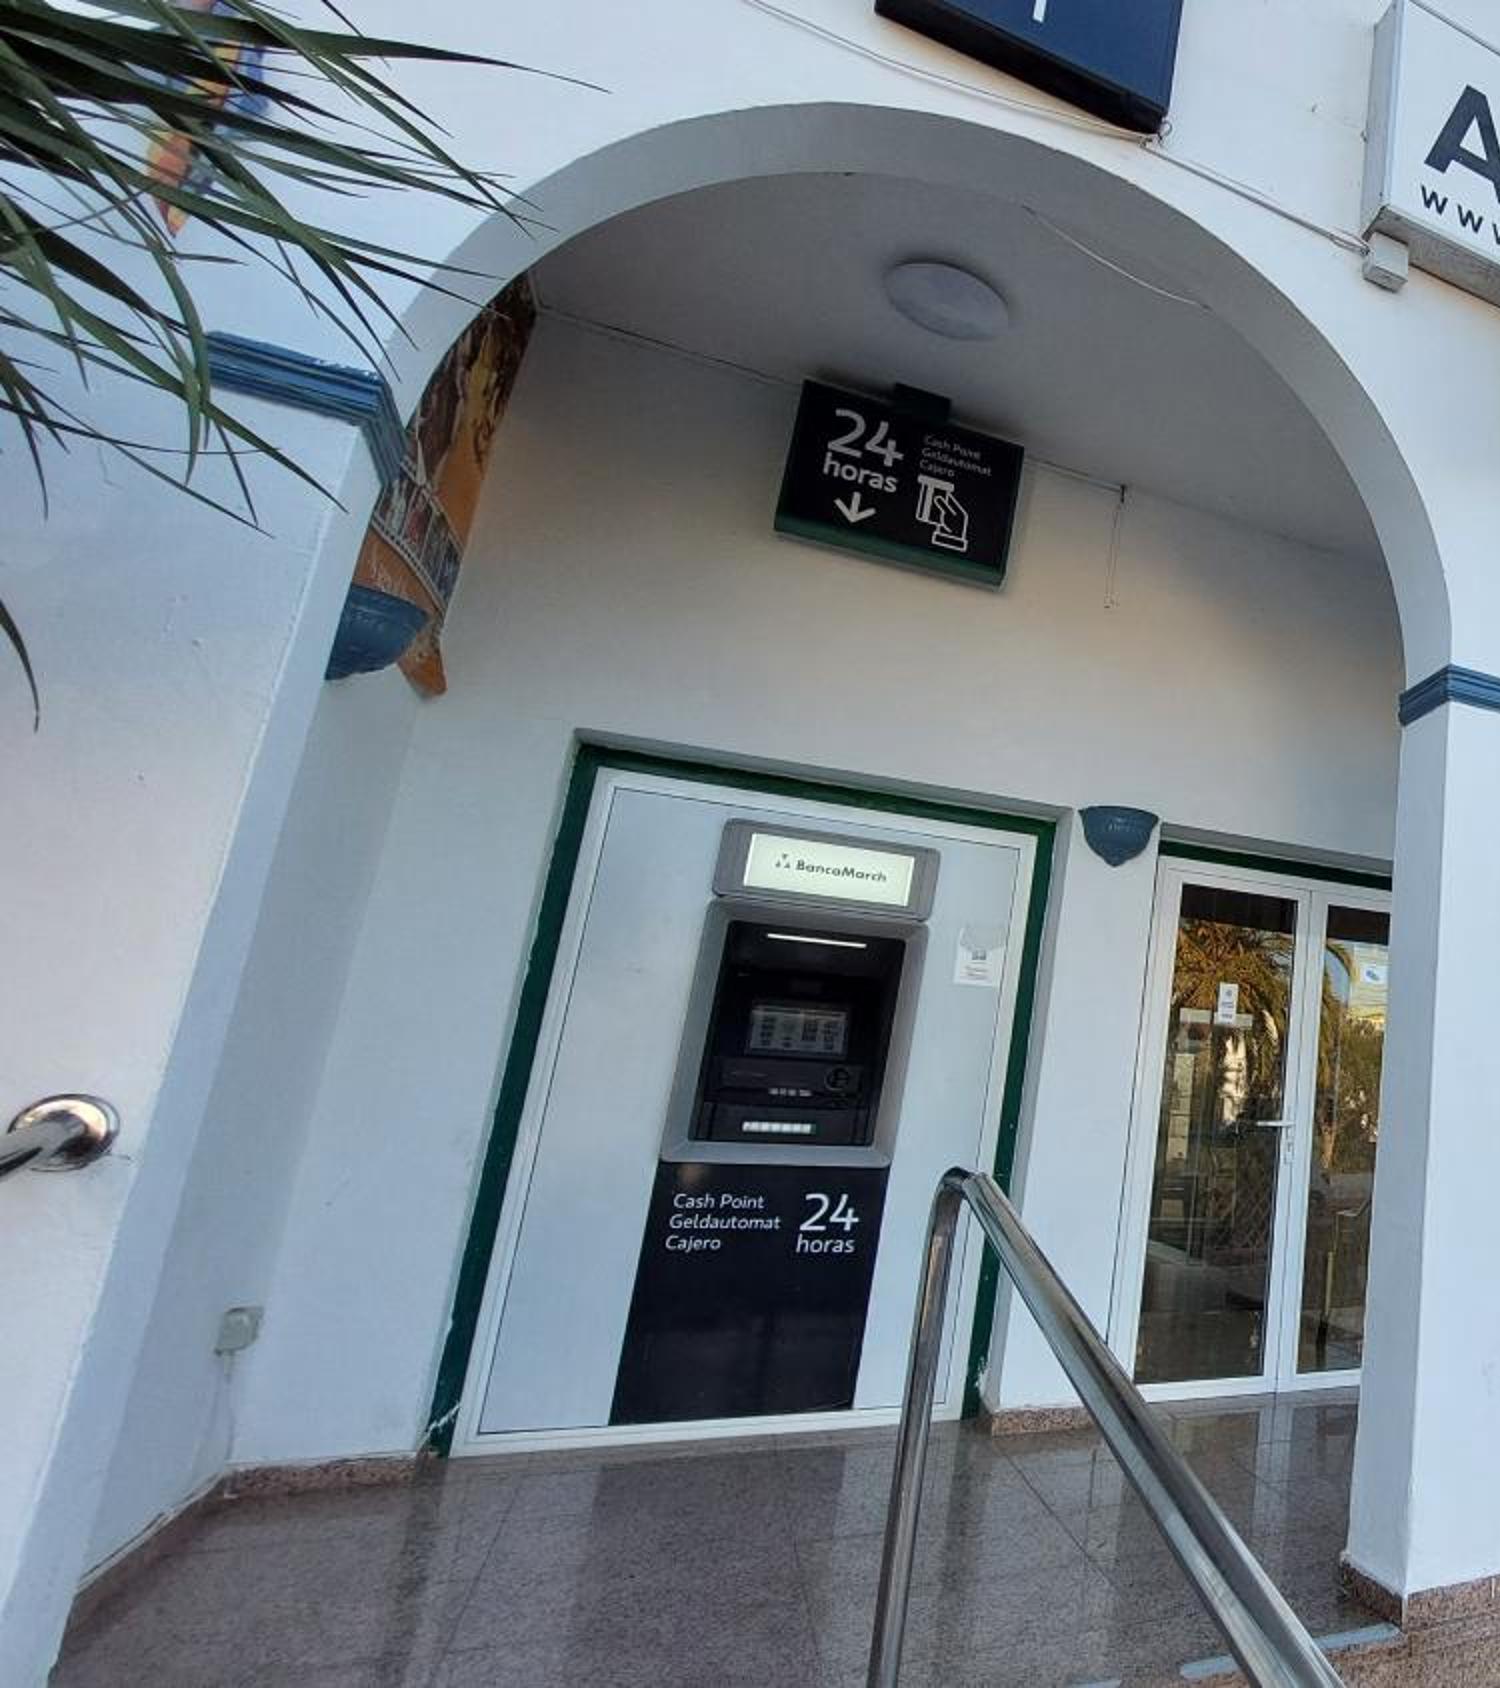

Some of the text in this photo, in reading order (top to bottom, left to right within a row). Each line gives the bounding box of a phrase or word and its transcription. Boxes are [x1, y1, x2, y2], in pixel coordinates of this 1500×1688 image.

[827, 408, 904, 467] 24
[822, 452, 898, 493] horas
[674, 1193, 764, 1209] Cash Point
[669, 1214, 781, 1230] Geldautomat
[799, 1193, 859, 1231] 24
[665, 1234, 721, 1254] Cajero
[796, 1234, 855, 1254] horas
